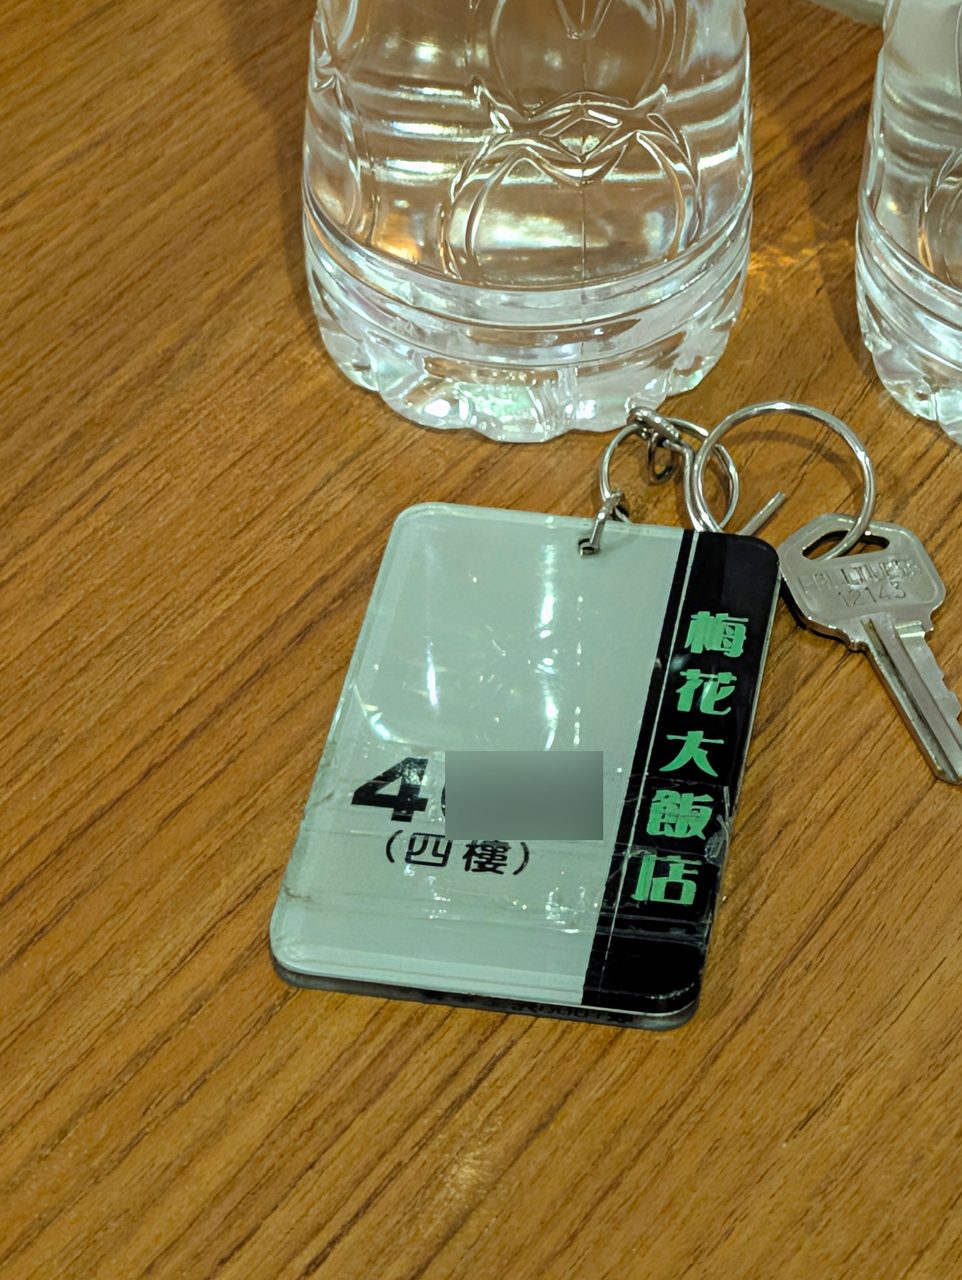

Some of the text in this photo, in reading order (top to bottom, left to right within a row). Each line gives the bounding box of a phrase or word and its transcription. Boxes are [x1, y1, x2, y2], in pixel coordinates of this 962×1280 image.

[630, 610, 749, 907] 梅花大飯店
